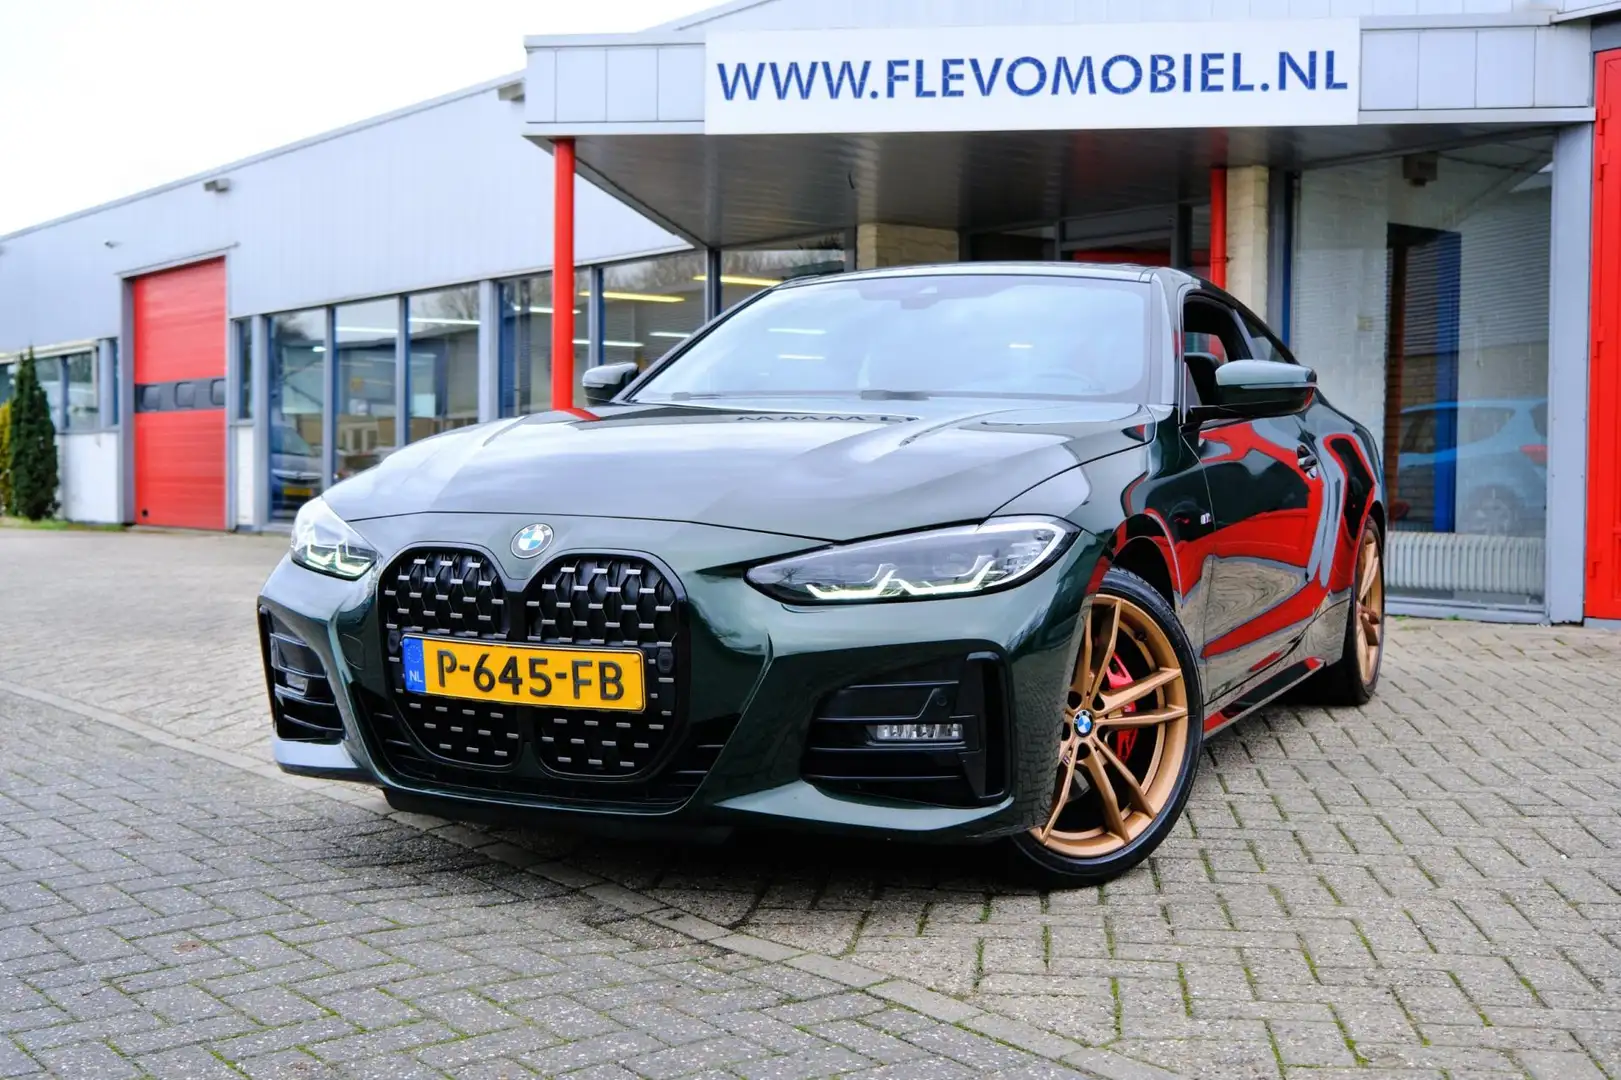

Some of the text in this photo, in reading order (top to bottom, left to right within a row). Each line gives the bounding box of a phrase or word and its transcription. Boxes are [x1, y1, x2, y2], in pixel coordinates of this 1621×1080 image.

[717, 50, 1348, 100] WWW.FLEVOMOBIEL.NL
[409, 650, 625, 701] NL P-645-FB
